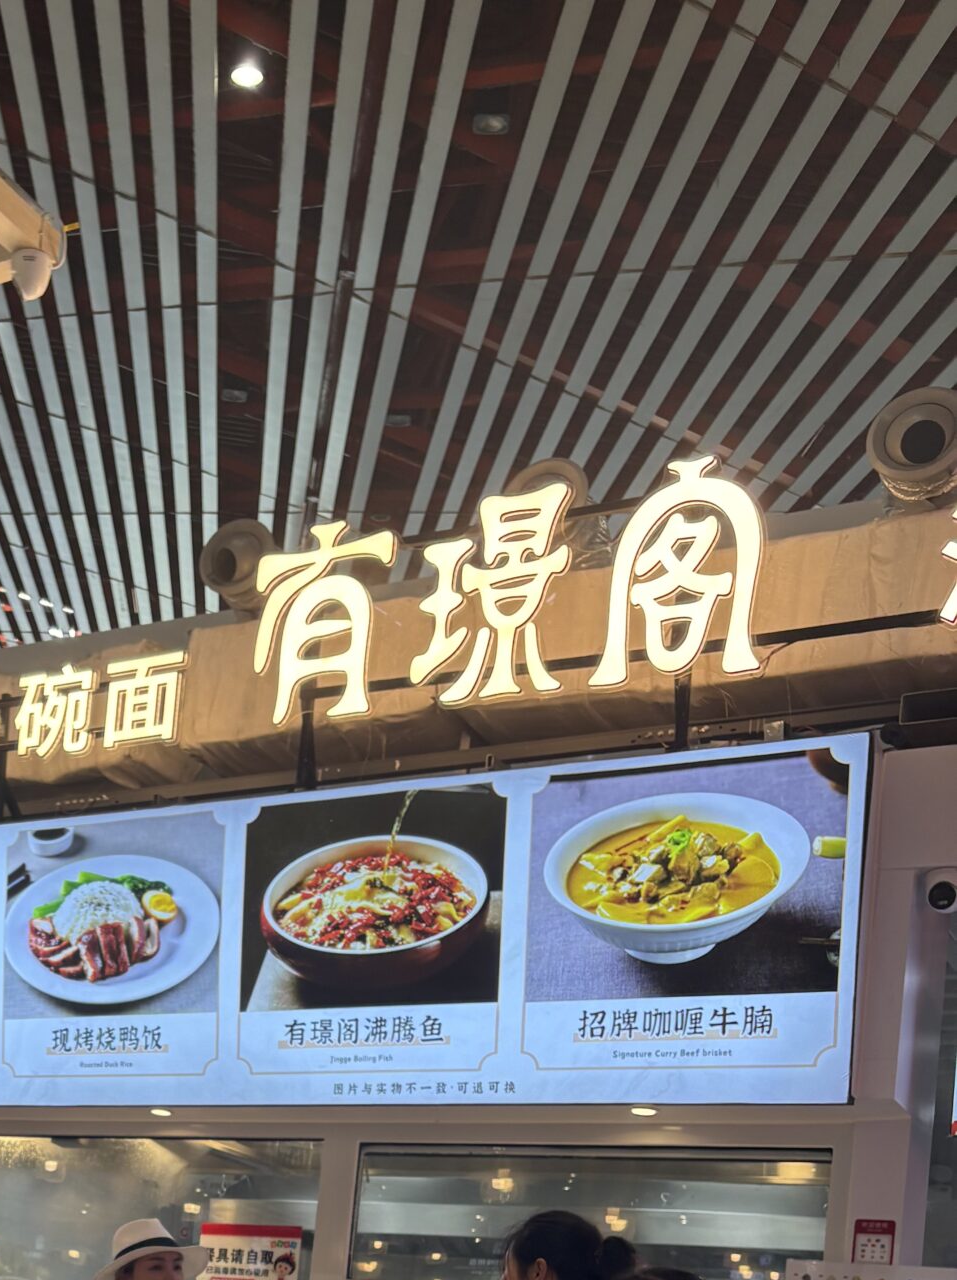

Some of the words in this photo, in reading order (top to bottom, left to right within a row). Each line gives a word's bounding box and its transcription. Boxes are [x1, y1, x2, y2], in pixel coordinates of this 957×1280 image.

[285, 1015, 444, 1046] 有璟阁沸腾鱼
[578, 1005, 773, 1039] 招牌咖喱牛腩
[52, 1025, 163, 1052] 现烤烧鸭饭
[378, 1053, 393, 1062] Fish
[613, 1050, 652, 1060] Signature
[654, 1050, 677, 1059] Curry
[680, 1048, 700, 1058] Beef
[702, 1048, 732, 1058] brisket
